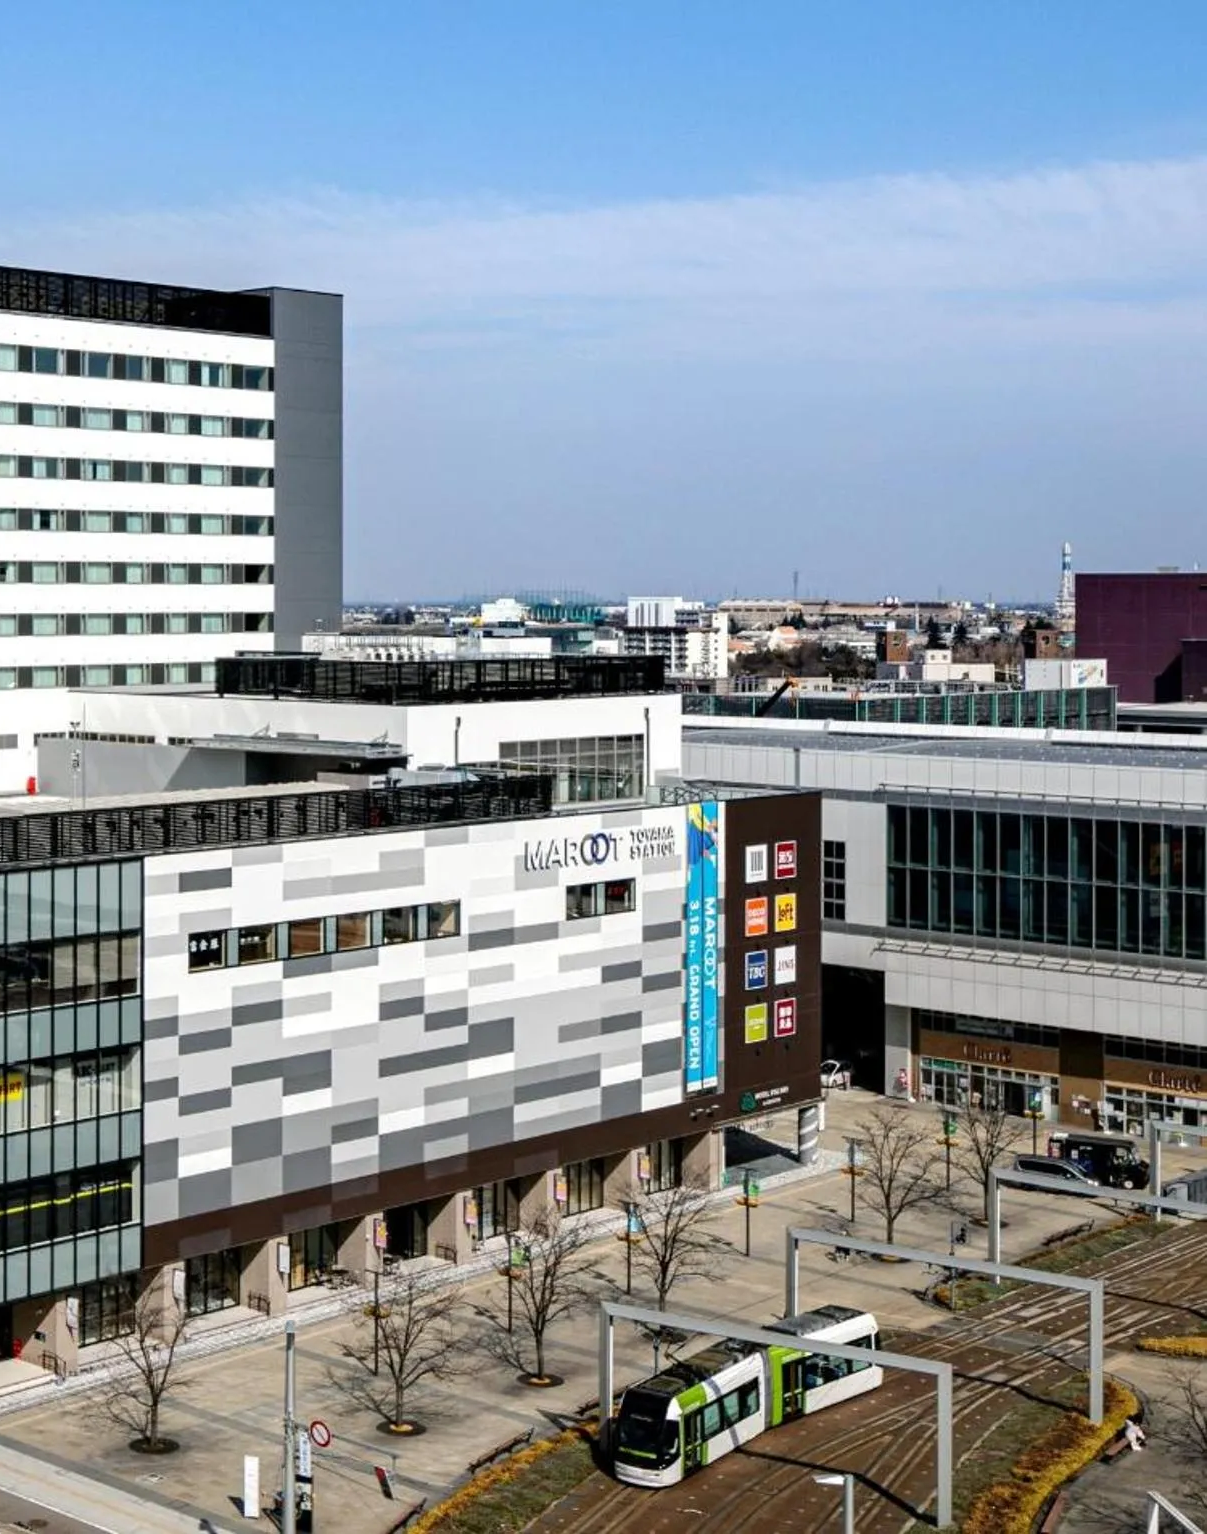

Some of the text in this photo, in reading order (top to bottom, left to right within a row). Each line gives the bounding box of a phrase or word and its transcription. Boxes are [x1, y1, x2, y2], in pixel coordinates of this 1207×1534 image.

[524, 833, 622, 872] MAROOT
[688, 900, 700, 937] 3.18
[689, 965, 700, 1021] GRAND
[689, 1025, 700, 1069] OPEN
